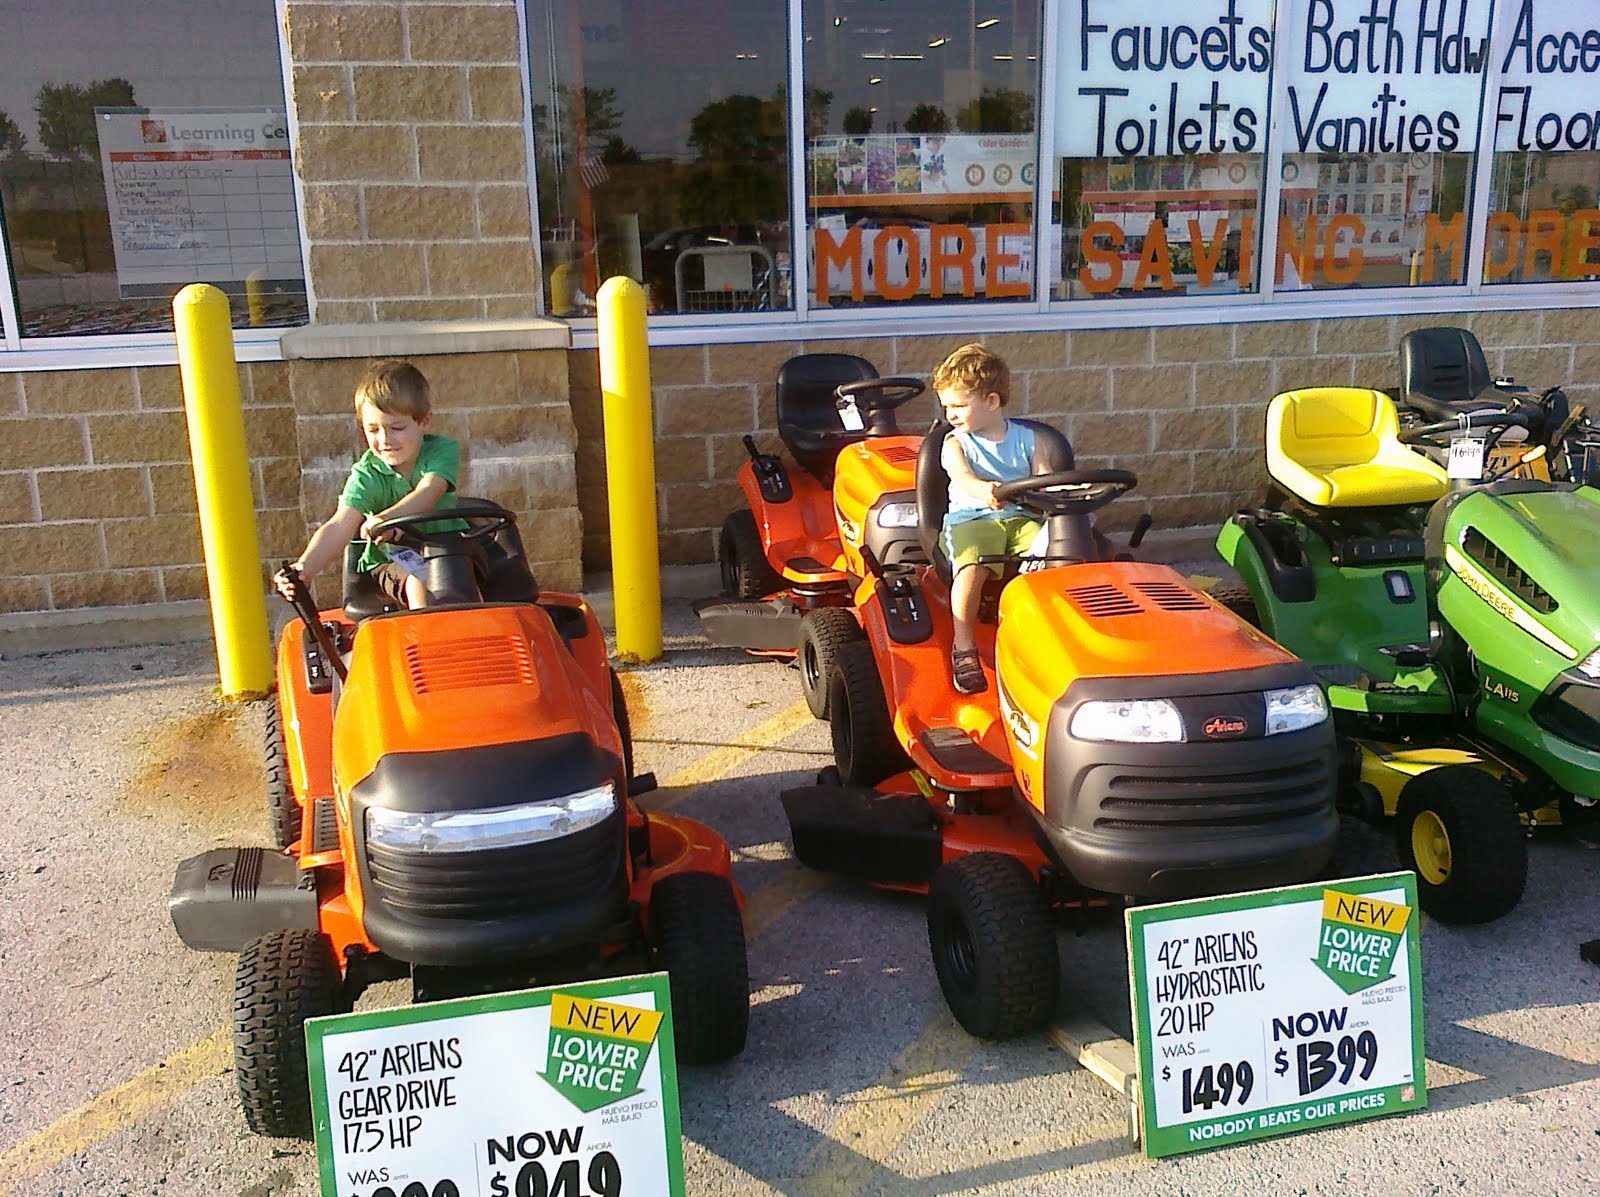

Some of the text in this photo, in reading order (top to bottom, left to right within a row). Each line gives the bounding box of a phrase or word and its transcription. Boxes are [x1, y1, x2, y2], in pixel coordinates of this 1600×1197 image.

[1081, 0, 1600, 74] Faucets Bath Hdw Acce
[171, 123, 255, 143] Learning
[1078, 81, 1257, 157] Toilets
[1287, 82, 1460, 153] Vanities
[815, 209, 1600, 307] MORE SAVING MORE
[1481, 583, 1516, 620] DEERE
[1336, 897, 1395, 927] NEW
[1158, 930, 1257, 970] 42" ARIENS
[1323, 926, 1391, 958] LOWER
[1327, 948, 1381, 978] PRICE
[1156, 963, 1265, 1003] HYDROSTATIC
[567, 1001, 641, 1035] NEW
[1157, 1002, 1214, 1036] 20 HP
[1272, 1006, 1348, 1041] NOW
[338, 1038, 462, 1082] 42" ARIENS
[551, 1034, 640, 1070] LOWER
[1162, 1042, 1195, 1058] WAS
[557, 1060, 626, 1092] PRICE
[1183, 1060, 1254, 1114] 1499
[339, 1076, 456, 1120] GEAR DRIVE
[601, 1100, 658, 1116] NUEVO PRECIO
[389, 1115, 422, 1149] HP
[621, 1112, 642, 1122] BAJO
[1189, 1093, 1385, 1141] NOBODY BEATS OUR PRICES
[487, 1126, 612, 1165] NOW AHORA
[347, 1166, 389, 1186] WAS
